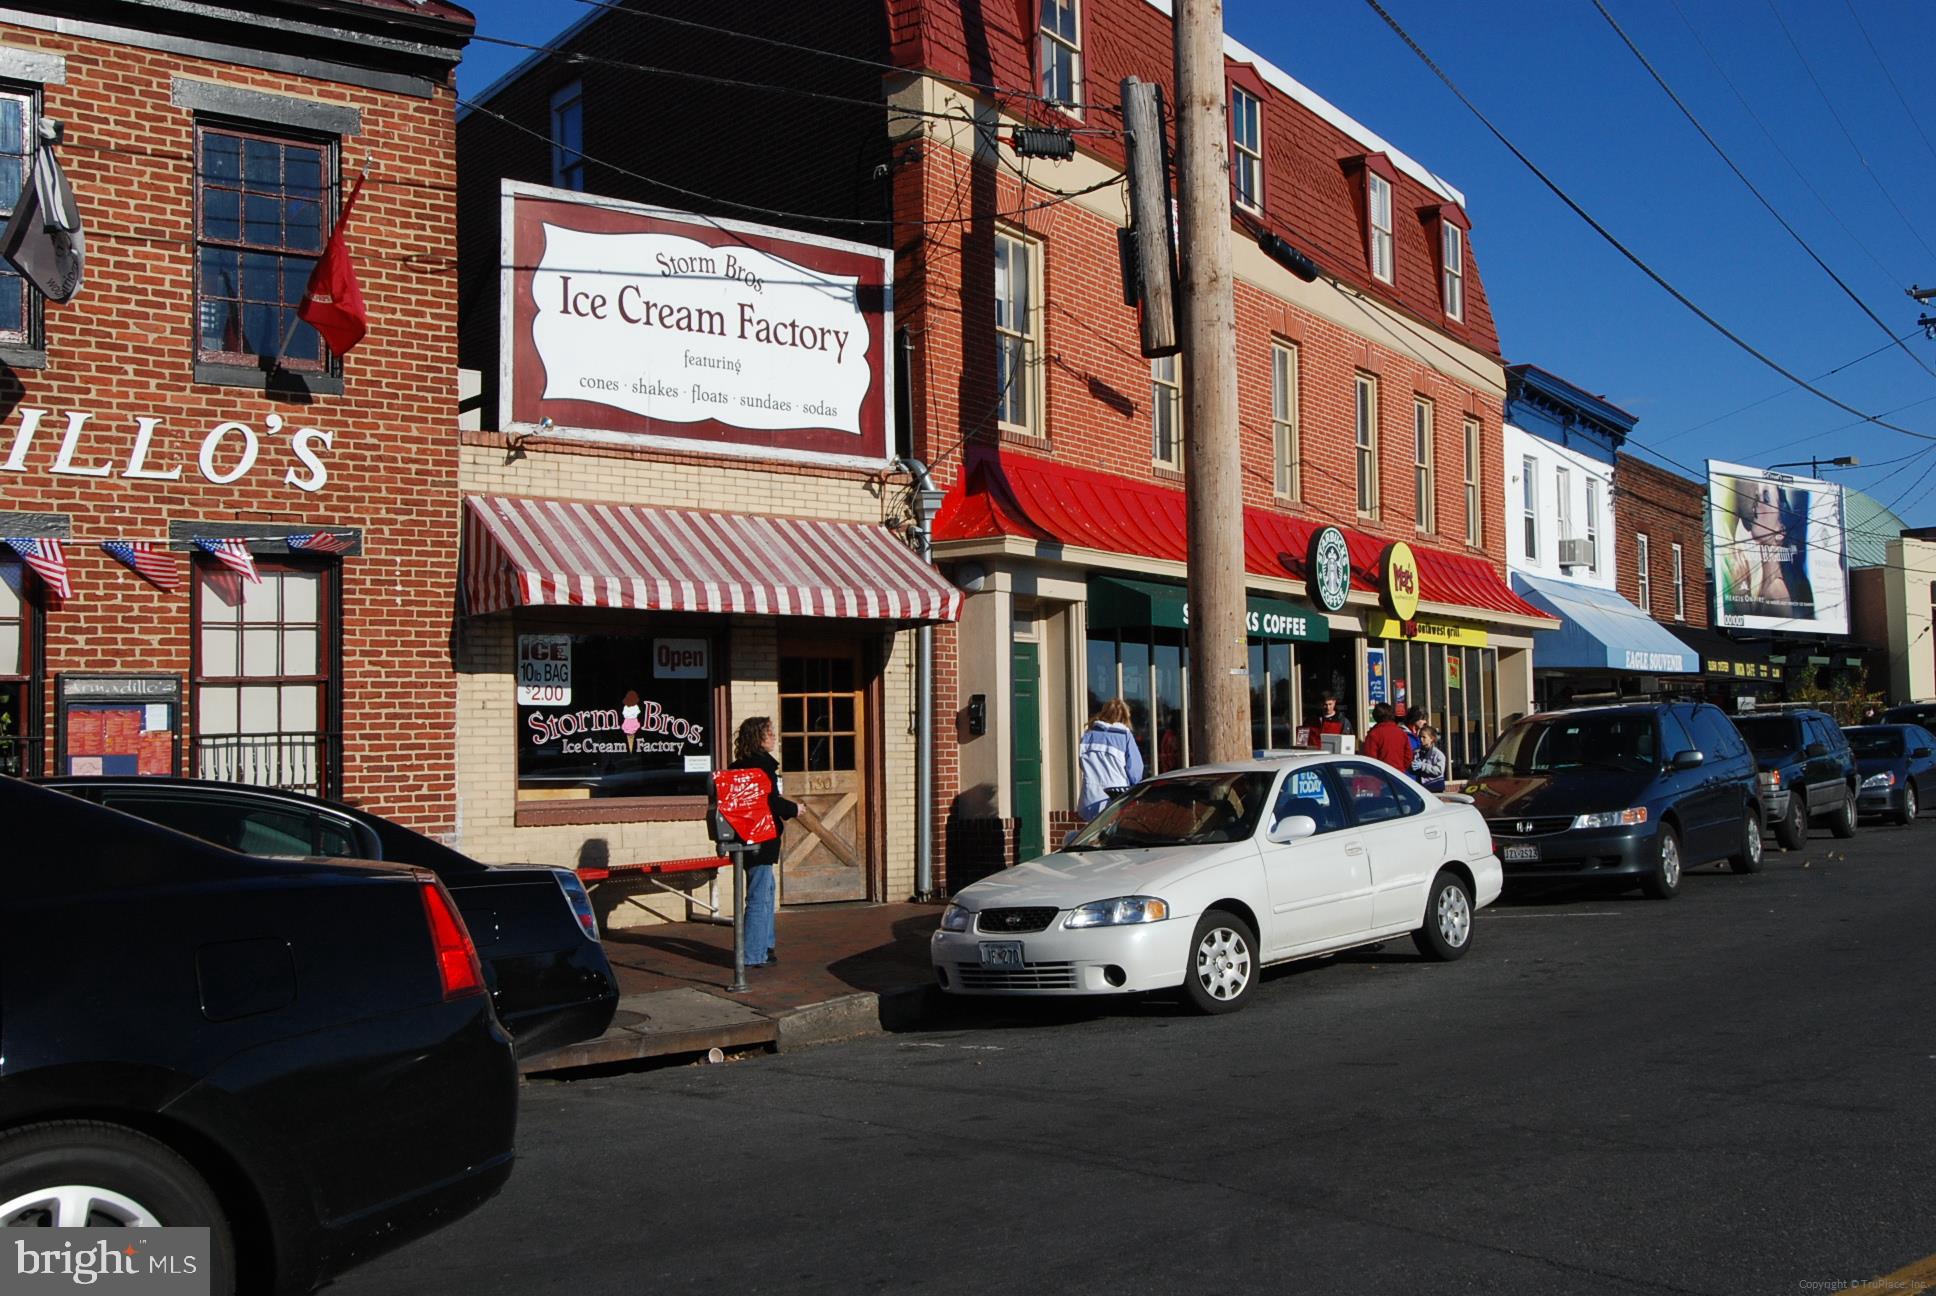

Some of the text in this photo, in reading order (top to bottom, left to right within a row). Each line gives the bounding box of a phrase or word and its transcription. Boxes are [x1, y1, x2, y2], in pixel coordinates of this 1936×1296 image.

[656, 252, 765, 295] Storm Bros.
[559, 275, 850, 364] Ice Cream Factory
[683, 349, 742, 375] featuring
[579, 376, 838, 417] cones shakes floats sundaes sodas
[1322, 585, 1346, 607] COFFEE
[1263, 613, 1306, 636] COFFEE
[521, 640, 568, 661] ICE
[658, 644, 704, 672] Open
[1625, 650, 1683, 672] EAGLE SOUVENIR
[545, 664, 568, 682] BAG
[525, 685, 563, 701] $2.00
[528, 700, 703, 747] Storm Bros.
[562, 738, 684, 756] Ice Cream Factory
[1299, 780, 1322, 794] TODAY
